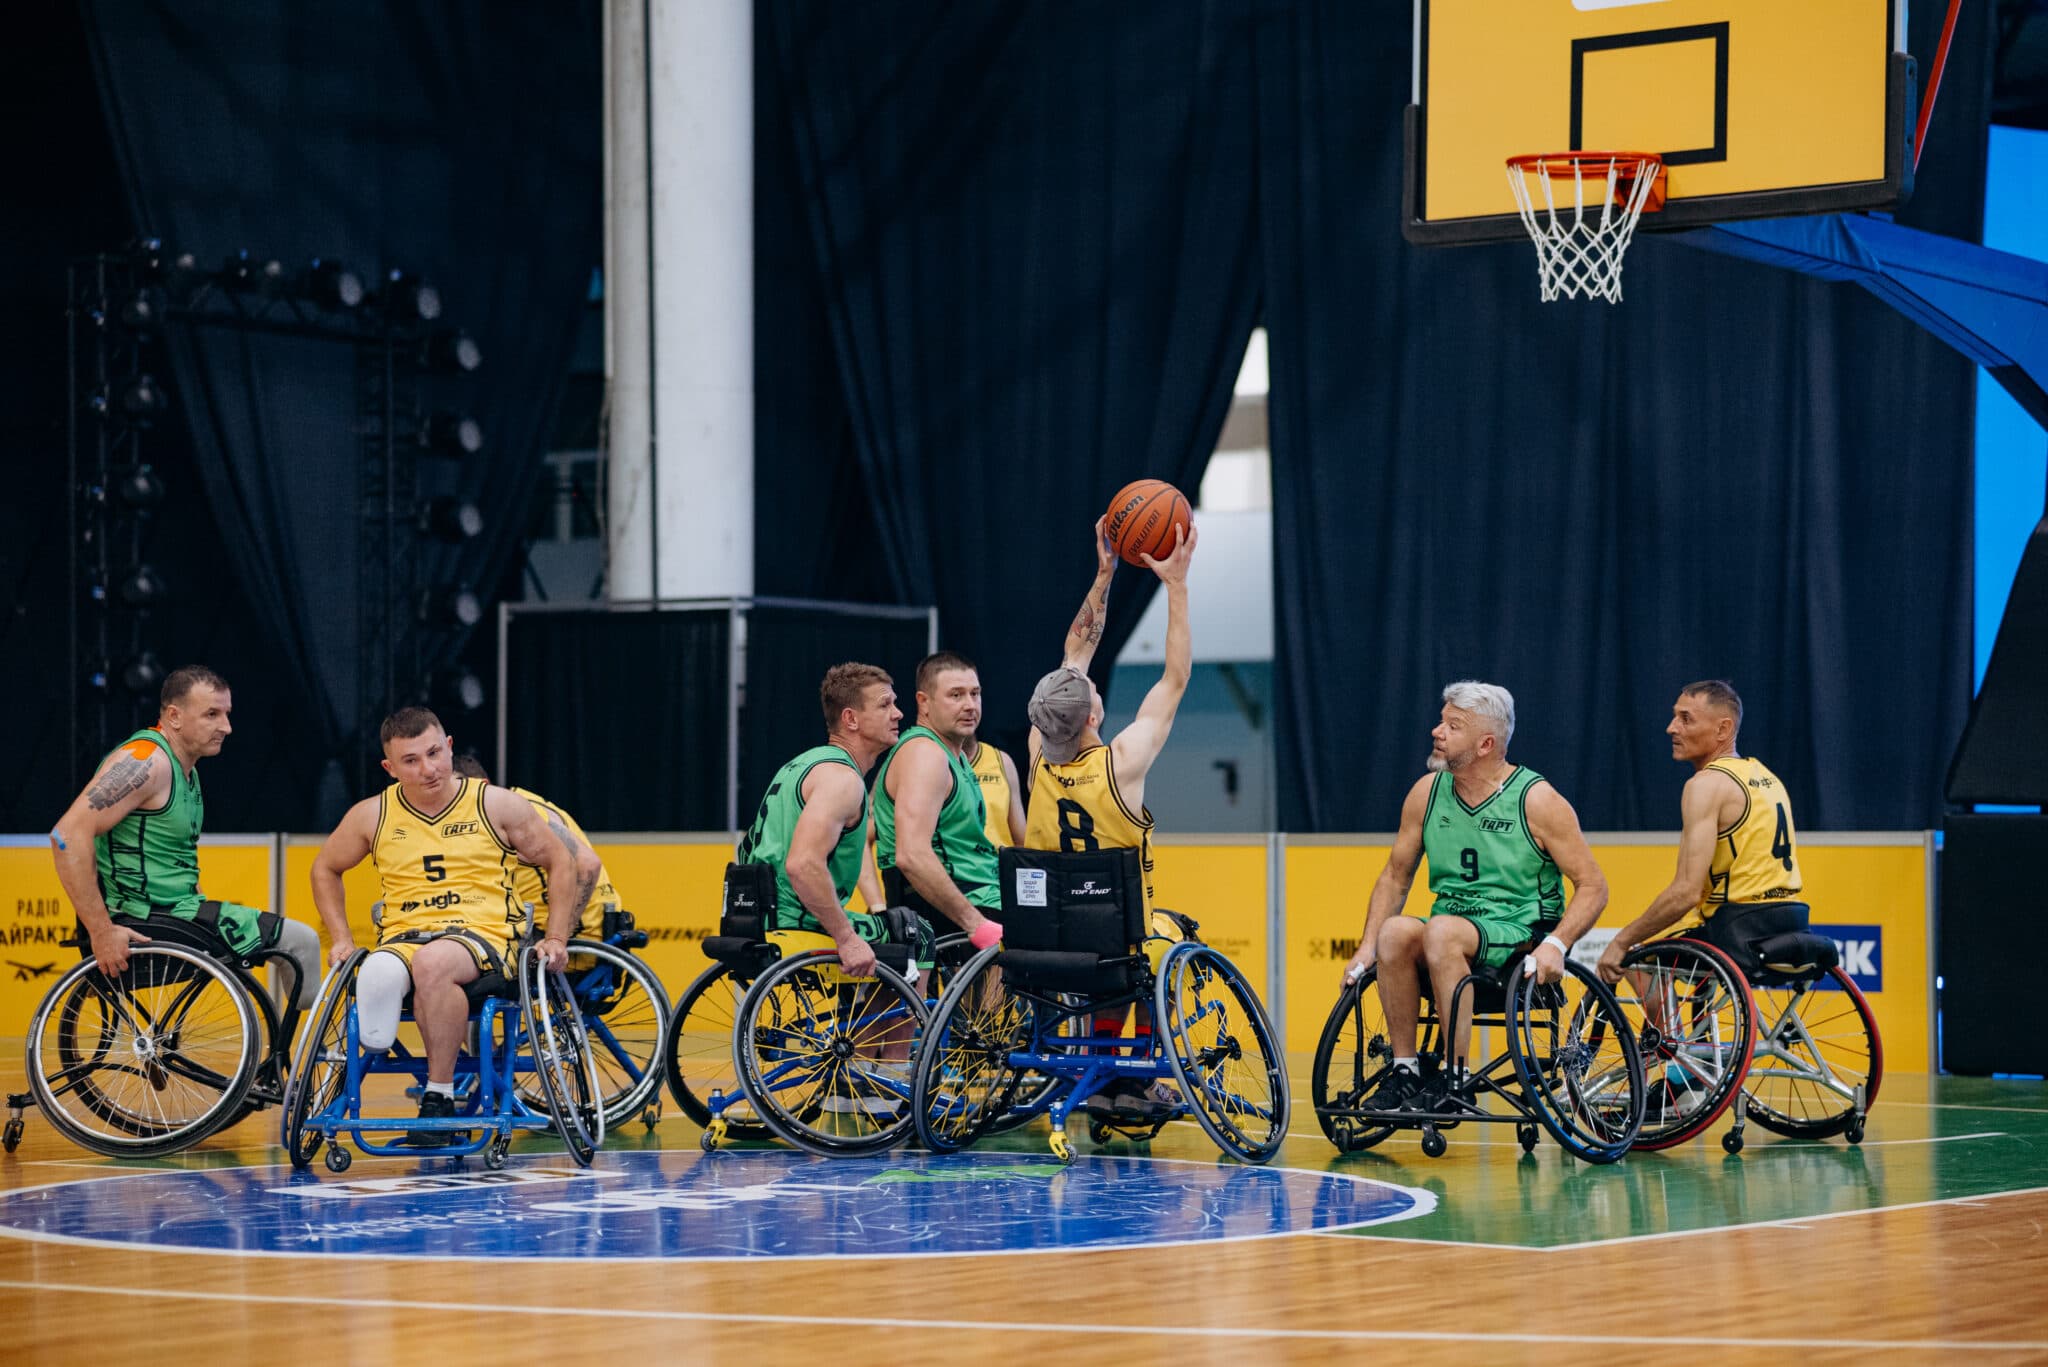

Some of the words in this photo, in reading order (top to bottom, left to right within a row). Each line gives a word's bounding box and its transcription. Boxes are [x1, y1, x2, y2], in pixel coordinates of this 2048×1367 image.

[1057, 797, 1099, 852] 8
[1771, 802, 1793, 871] 4
[423, 854, 446, 882] 5
[1460, 848, 1479, 882] 9
[17, 899, 59, 917] РАДІО
[424, 890, 460, 909] ugb
[219, 916, 247, 947] 2
[636, 926, 712, 941] OEING
